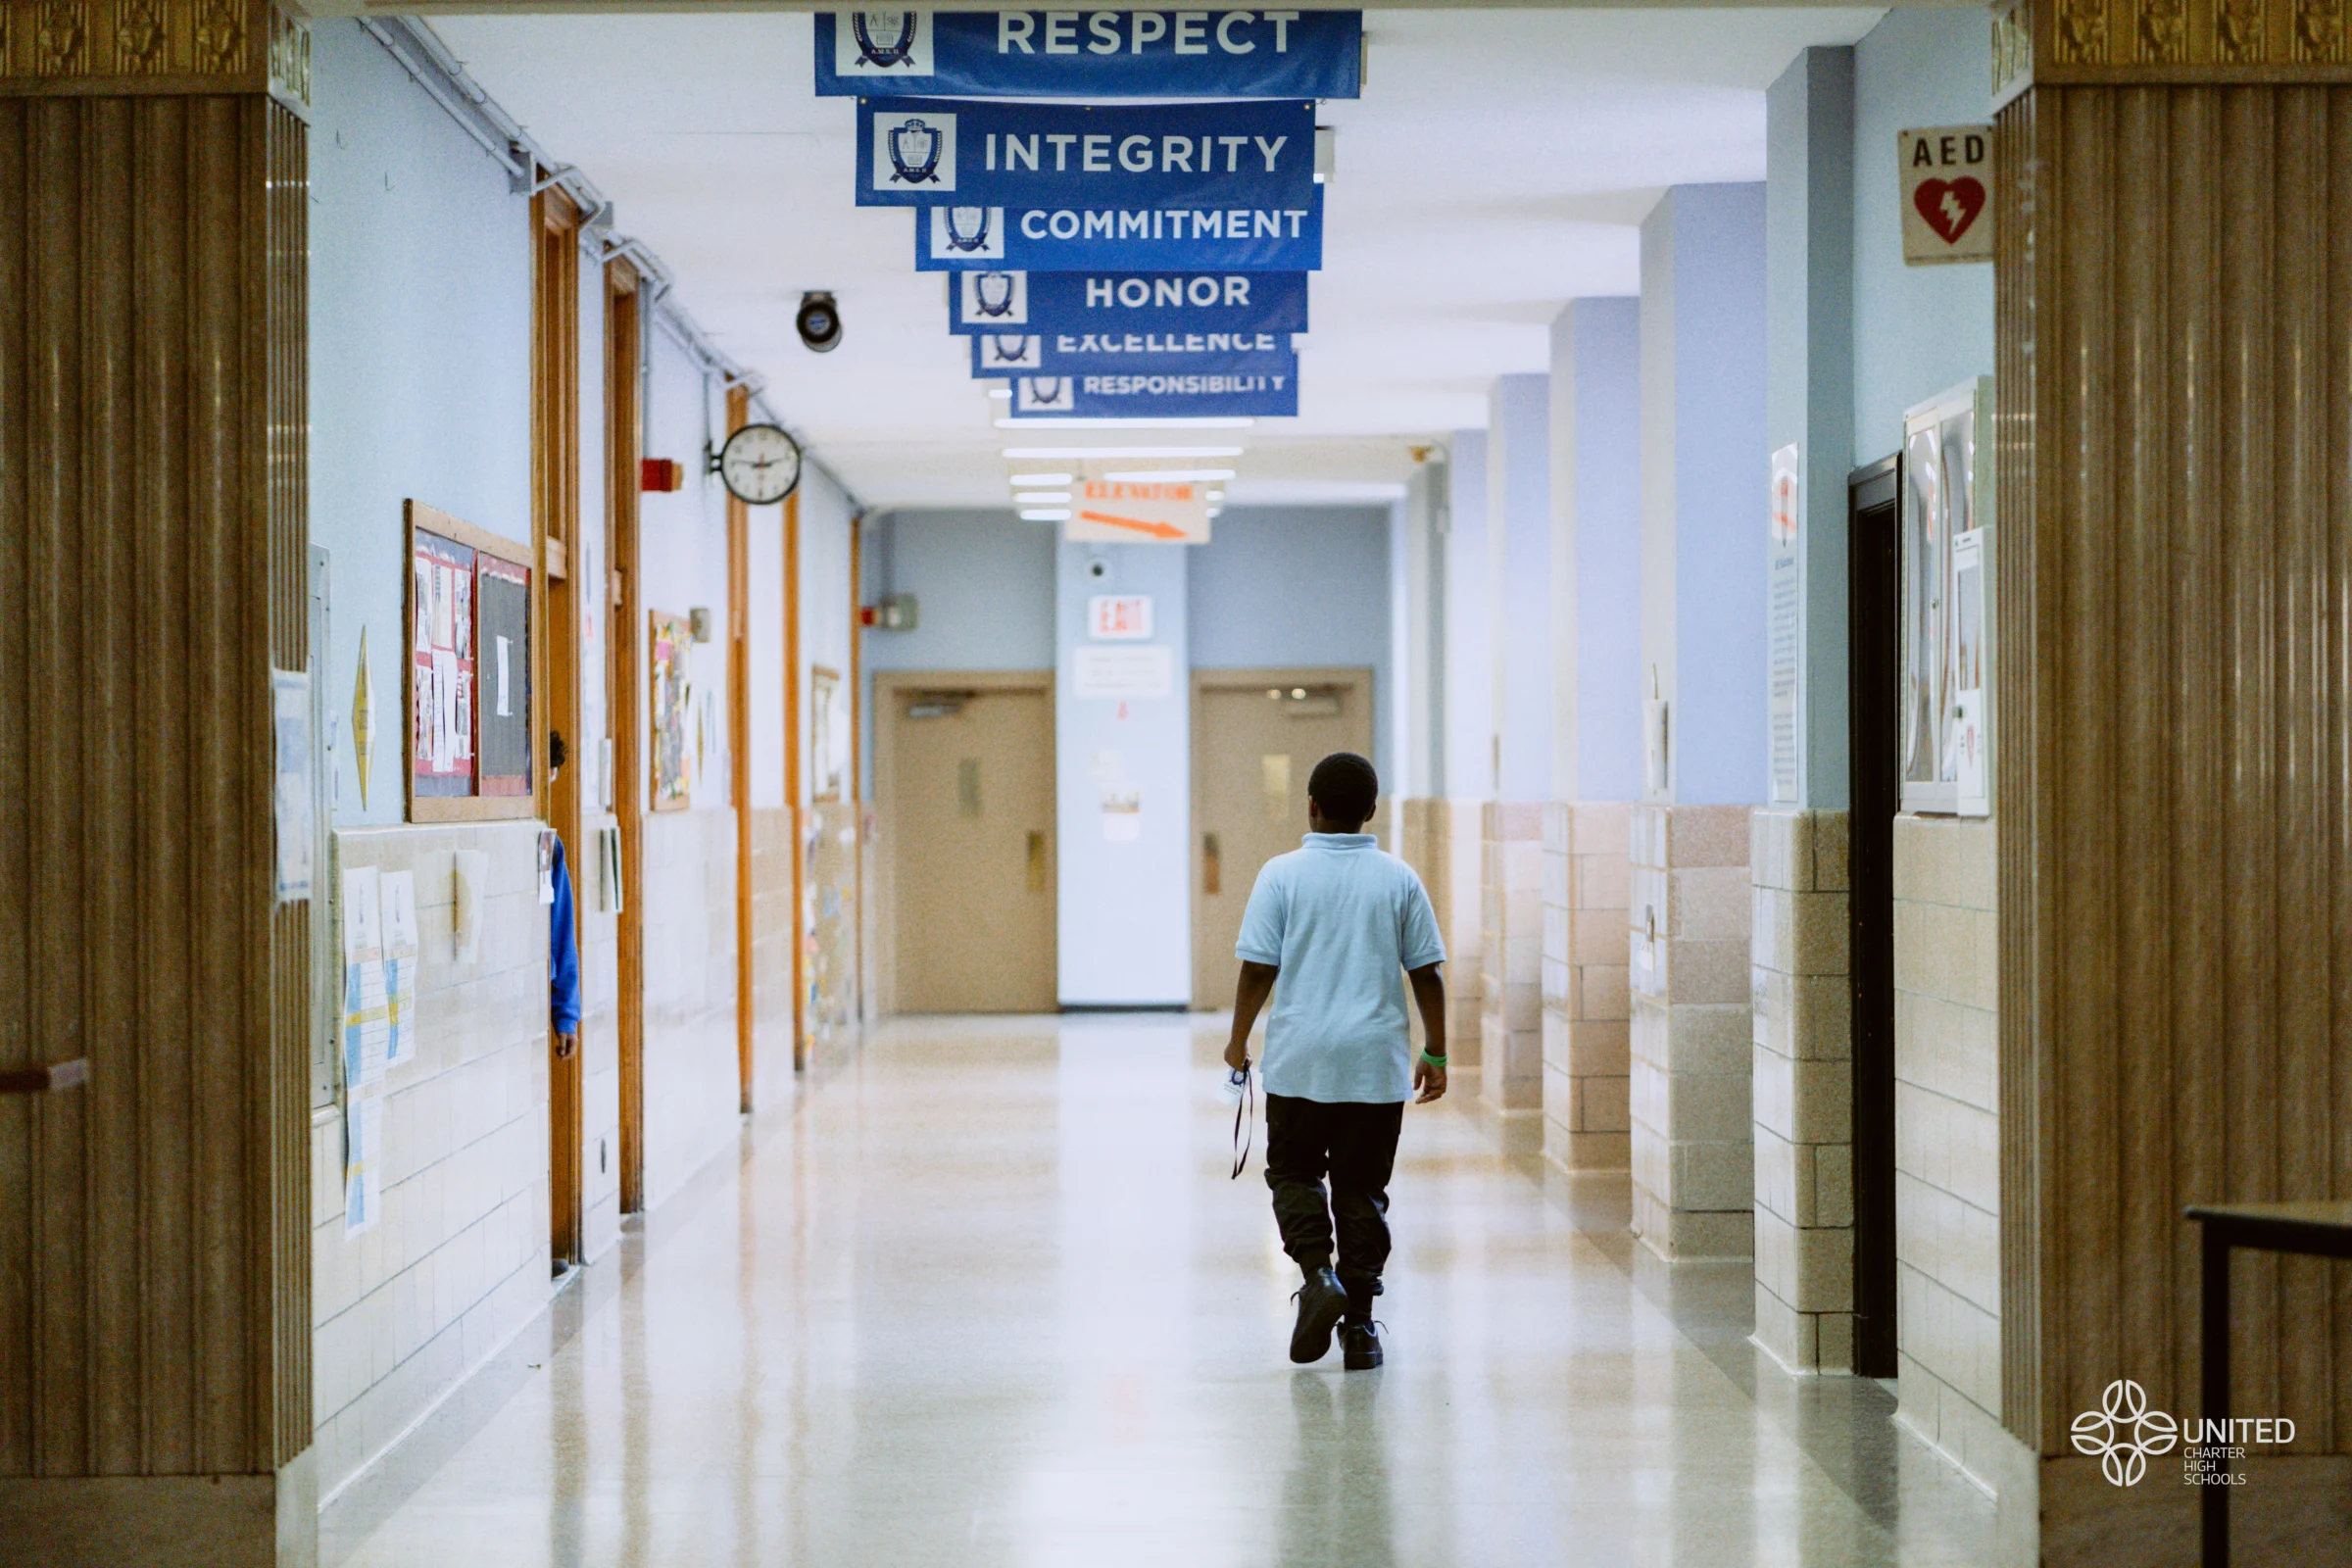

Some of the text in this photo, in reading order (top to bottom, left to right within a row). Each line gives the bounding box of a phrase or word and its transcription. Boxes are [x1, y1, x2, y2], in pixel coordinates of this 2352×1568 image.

[997, 11, 1300, 55] RESPECT
[985, 132, 1288, 172] INTEGRITY
[1912, 133, 1985, 168] AED
[1020, 209, 1308, 240] COMMITMENT
[1085, 275, 1251, 309] HONOR
[1056, 333, 1276, 353] EXCELLENCE
